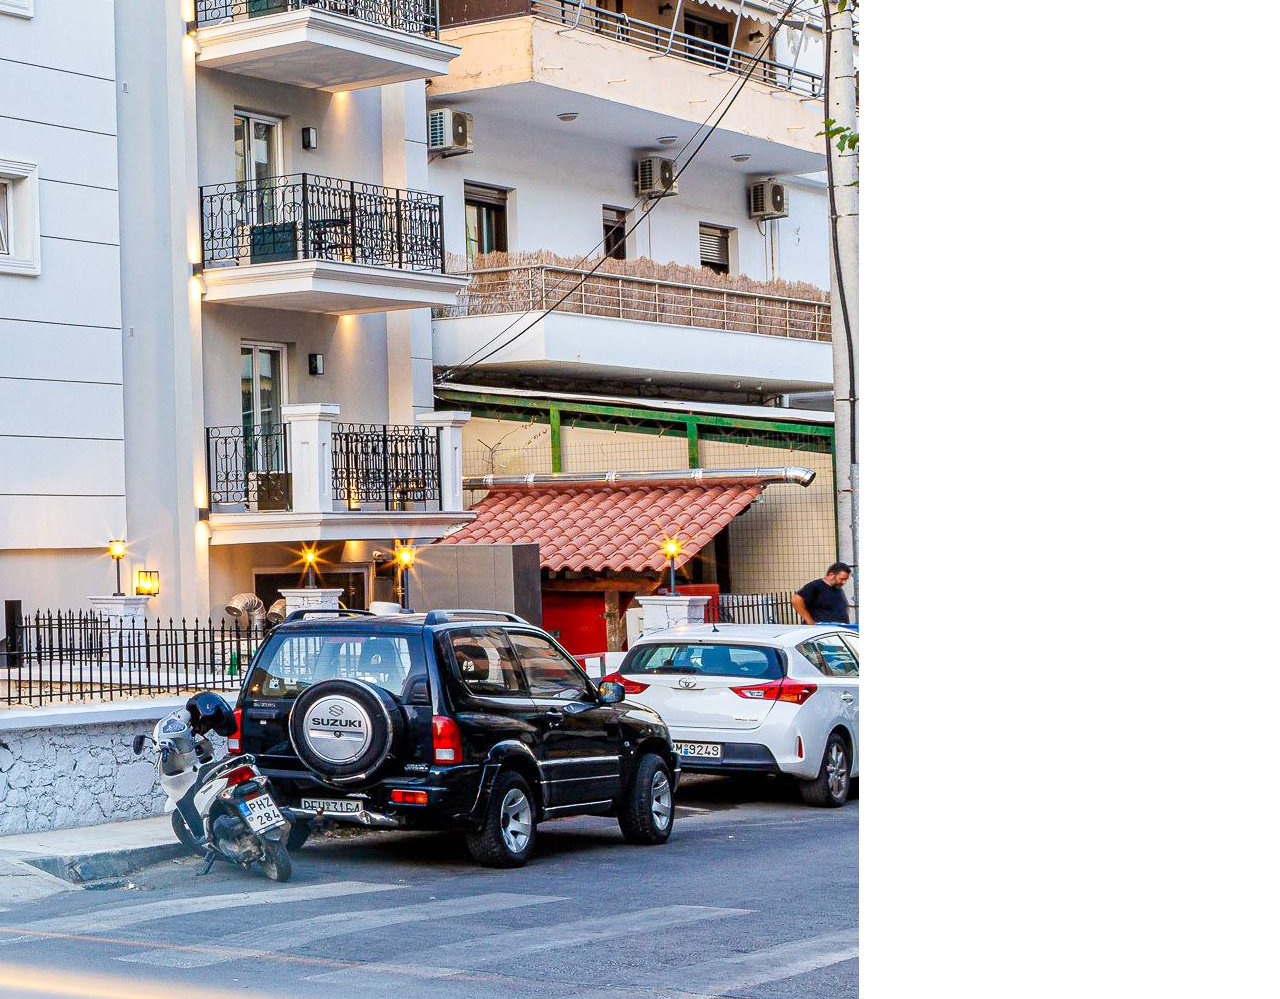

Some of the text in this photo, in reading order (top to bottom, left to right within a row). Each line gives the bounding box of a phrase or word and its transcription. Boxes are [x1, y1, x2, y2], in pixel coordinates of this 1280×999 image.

[311, 717, 362, 728] SUZUKI
[248, 797, 274, 812] PHZ
[256, 809, 281, 826] 284
